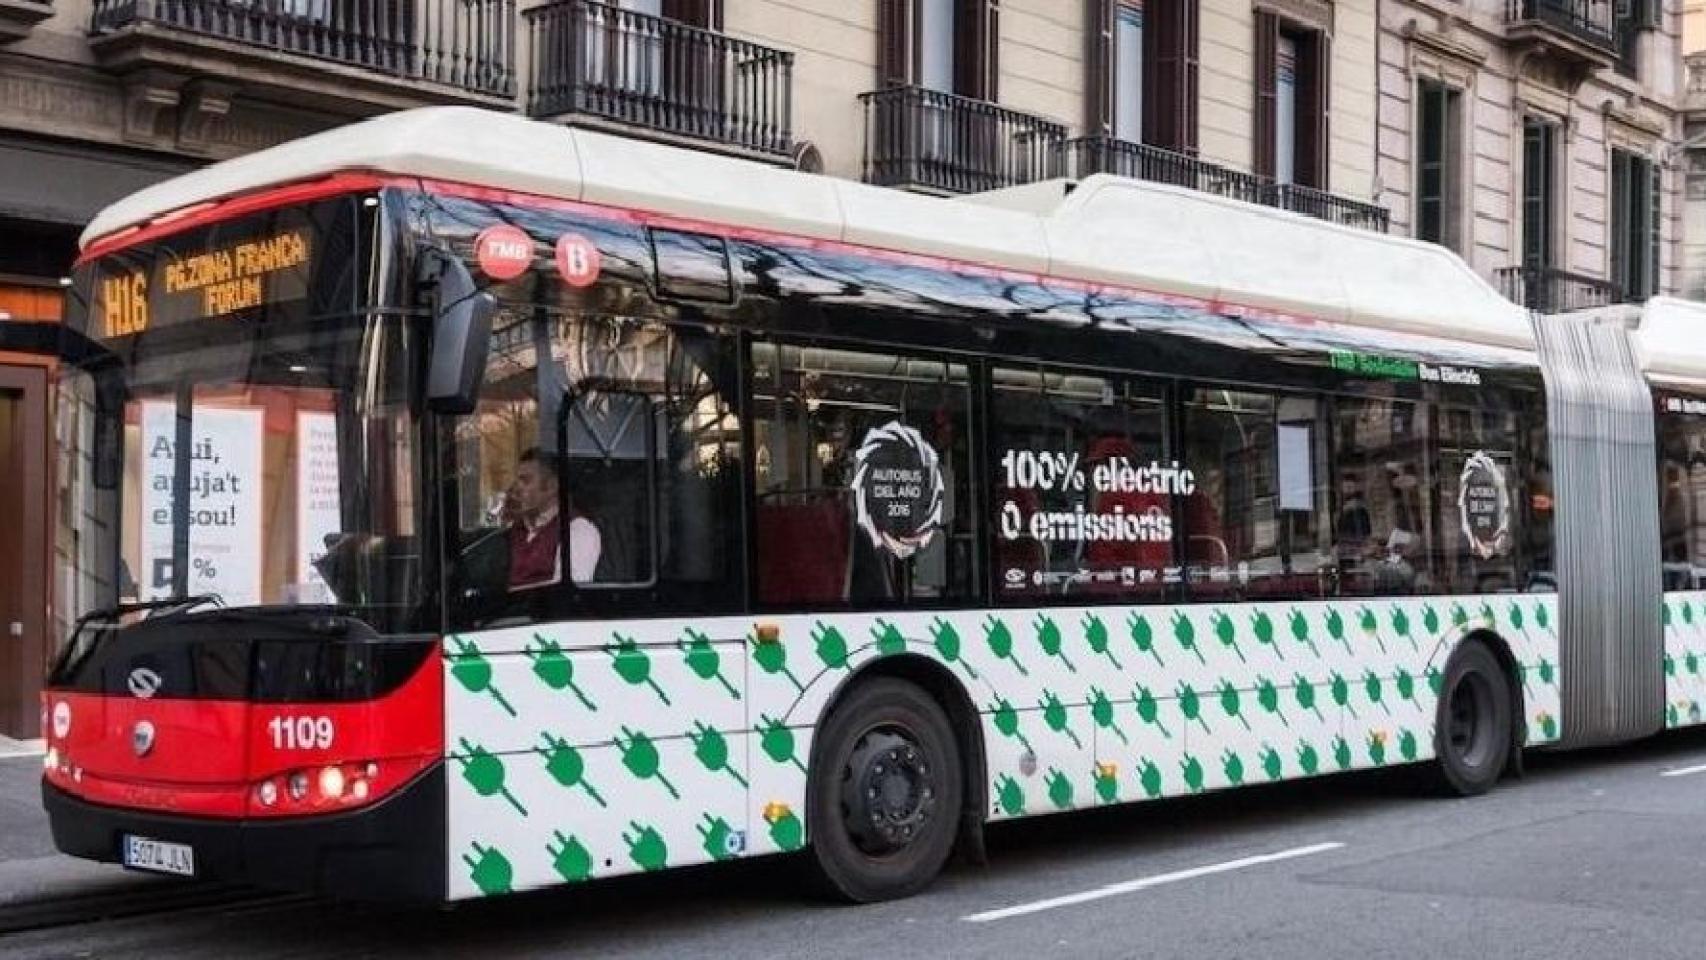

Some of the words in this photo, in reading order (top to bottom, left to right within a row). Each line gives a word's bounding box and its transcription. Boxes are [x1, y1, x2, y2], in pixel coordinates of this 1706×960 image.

[236, 231, 308, 277] FRANCA
[488, 240, 528, 260] TMB
[566, 242, 590, 276] B
[104, 271, 148, 338] H16
[204, 274, 263, 317] FORUM
[150, 435, 221, 465] Aui,
[872, 468, 922, 481] AUTOBUS
[1001, 448, 1085, 492] 100%
[1093, 456, 1196, 497] elèctric
[874, 485, 897, 498] DEL
[1001, 500, 1021, 540] 0
[1029, 503, 1174, 542] emissions
[267, 715, 335, 750] 1109
